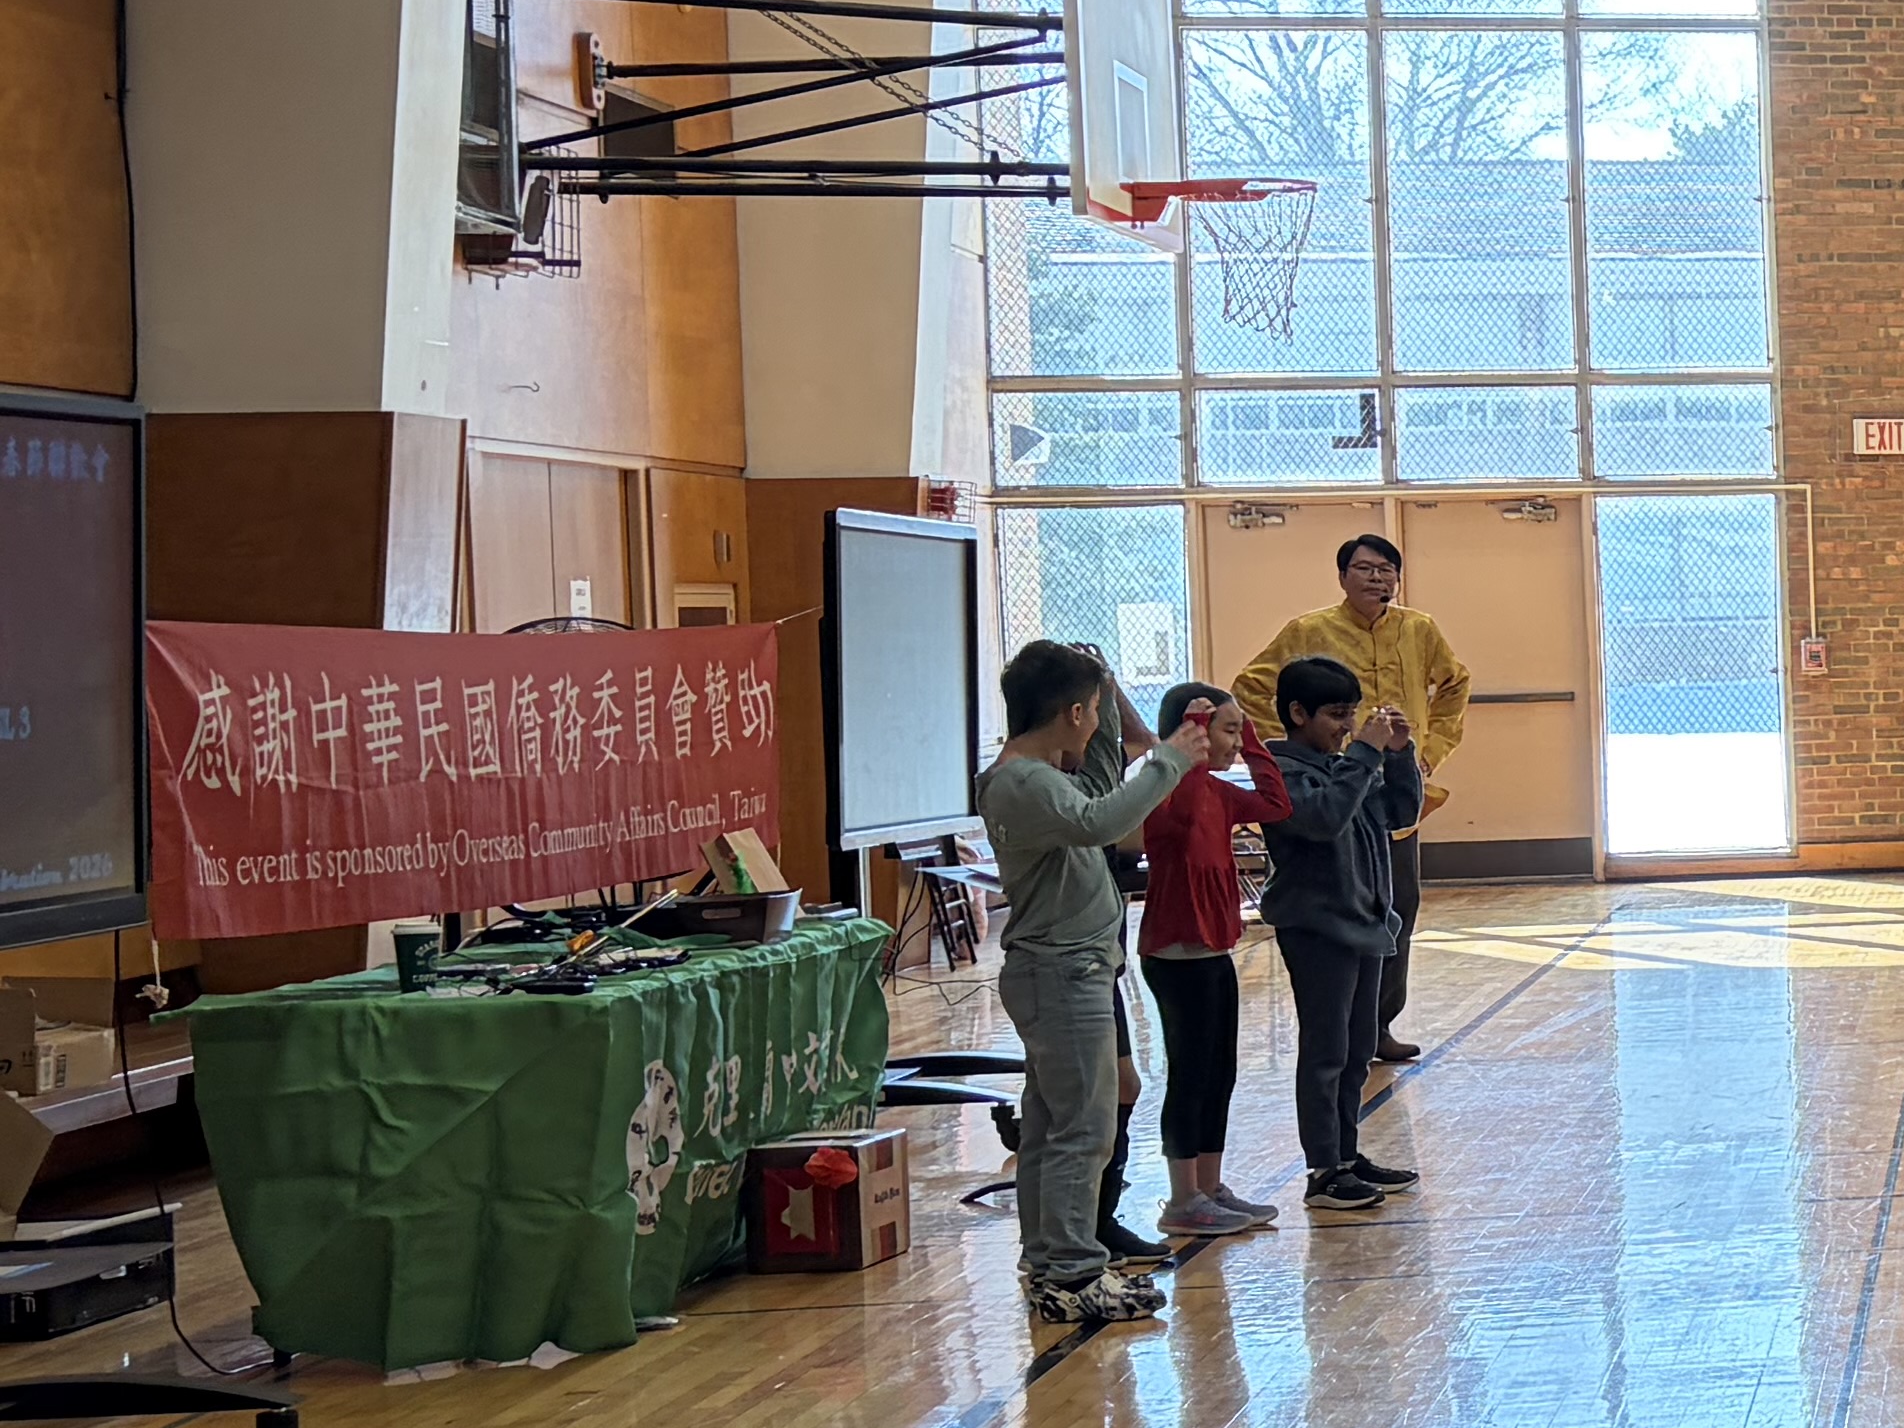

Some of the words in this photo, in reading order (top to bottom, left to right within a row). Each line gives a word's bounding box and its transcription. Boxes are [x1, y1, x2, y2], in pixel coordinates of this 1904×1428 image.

[1864, 421, 1904, 451] EXIT
[236, 849, 300, 885] event
[306, 838, 322, 880] is
[327, 832, 425, 888] sponsored
[426, 831, 450, 877] by
[453, 828, 525, 866] Overseas
[528, 814, 613, 859] Community
[616, 804, 666, 843] Affairs
